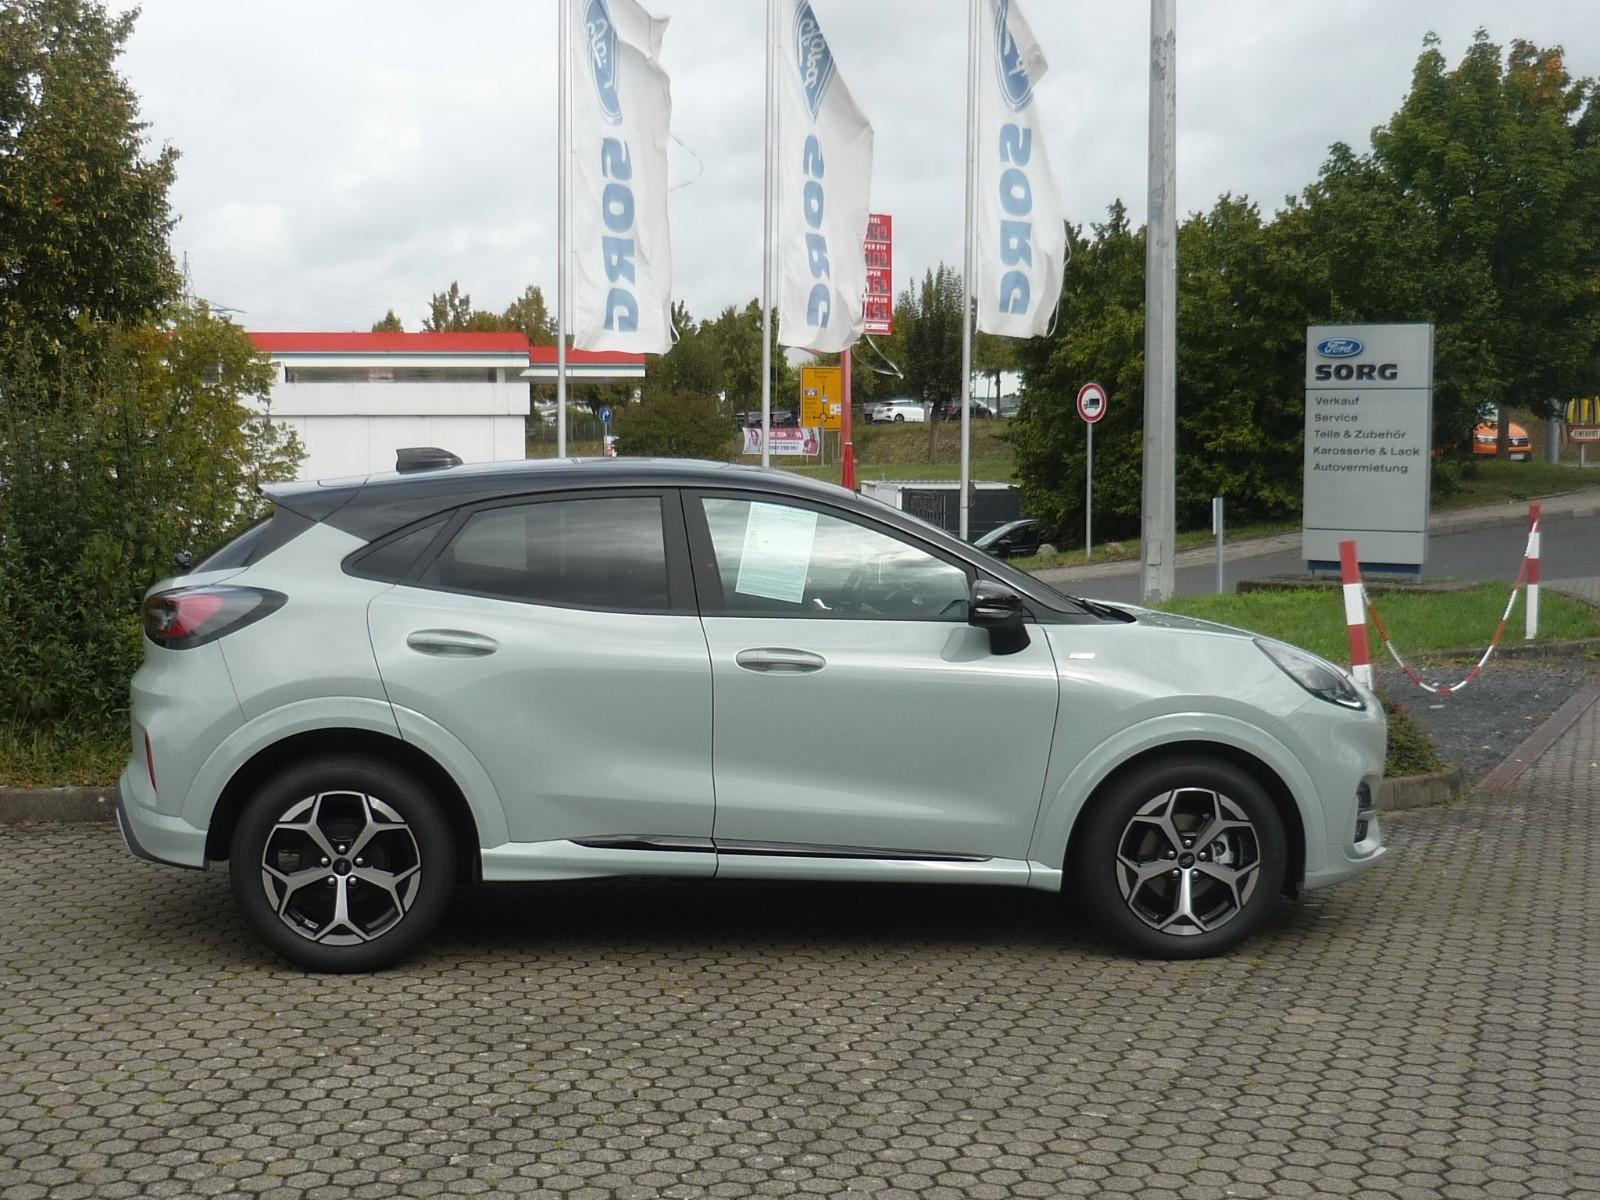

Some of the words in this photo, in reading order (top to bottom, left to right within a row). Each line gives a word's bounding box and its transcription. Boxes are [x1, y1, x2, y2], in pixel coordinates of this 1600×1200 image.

[1315, 364, 1398, 381] SORG
[1315, 396, 1360, 406] Verkauf
[1314, 413, 1358, 422] Service
[1314, 430, 1341, 439] Teile
[1343, 430, 1351, 439] &
[1354, 430, 1406, 439] Zubehör
[1313, 446, 1376, 456] Karosserie
[1379, 447, 1387, 456] &
[1391, 446, 1420, 456] Lack
[1313, 463, 1408, 474] Autovermietung
